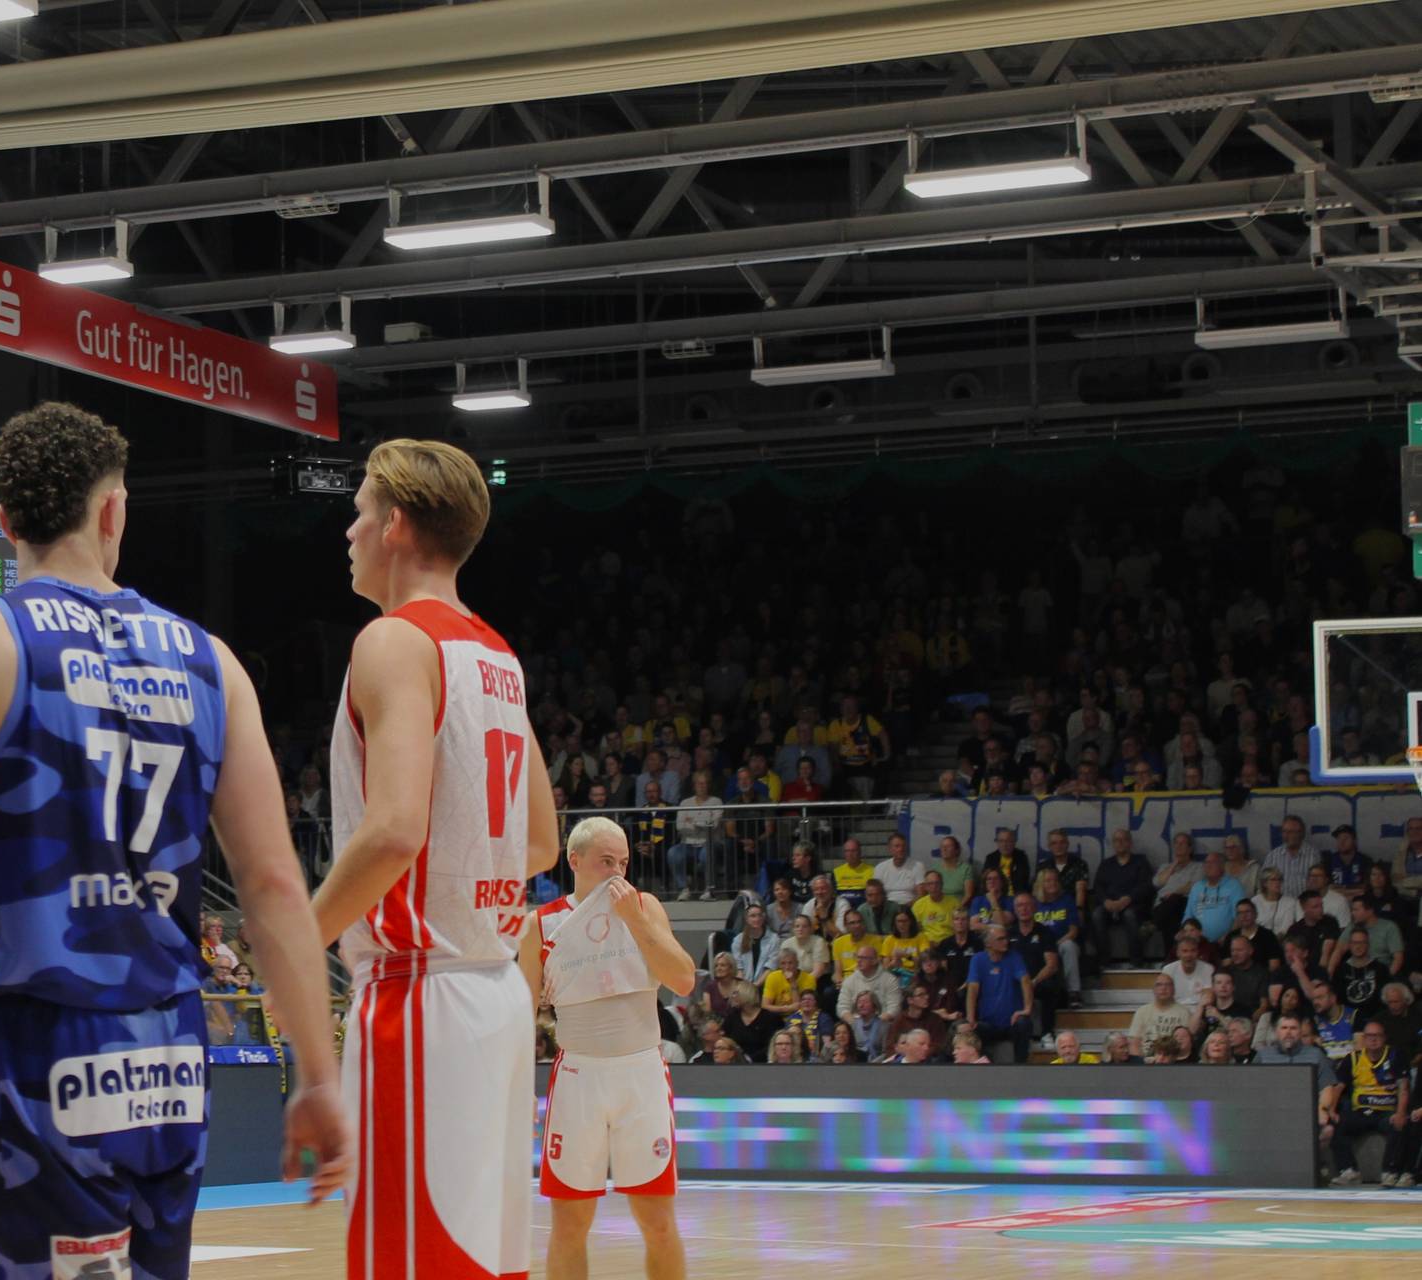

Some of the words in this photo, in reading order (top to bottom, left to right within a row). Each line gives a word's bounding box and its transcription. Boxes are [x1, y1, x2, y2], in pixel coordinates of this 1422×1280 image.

[77, 310, 122, 364] Gut
[127, 322, 163, 375] für
[170, 338, 250, 400] Hagen.
[24, 598, 195, 655] RISSETTO
[476, 659, 523, 706] BEYER
[85, 727, 185, 853] 77
[485, 728, 524, 838] 17
[549, 1133, 563, 1160] 5
